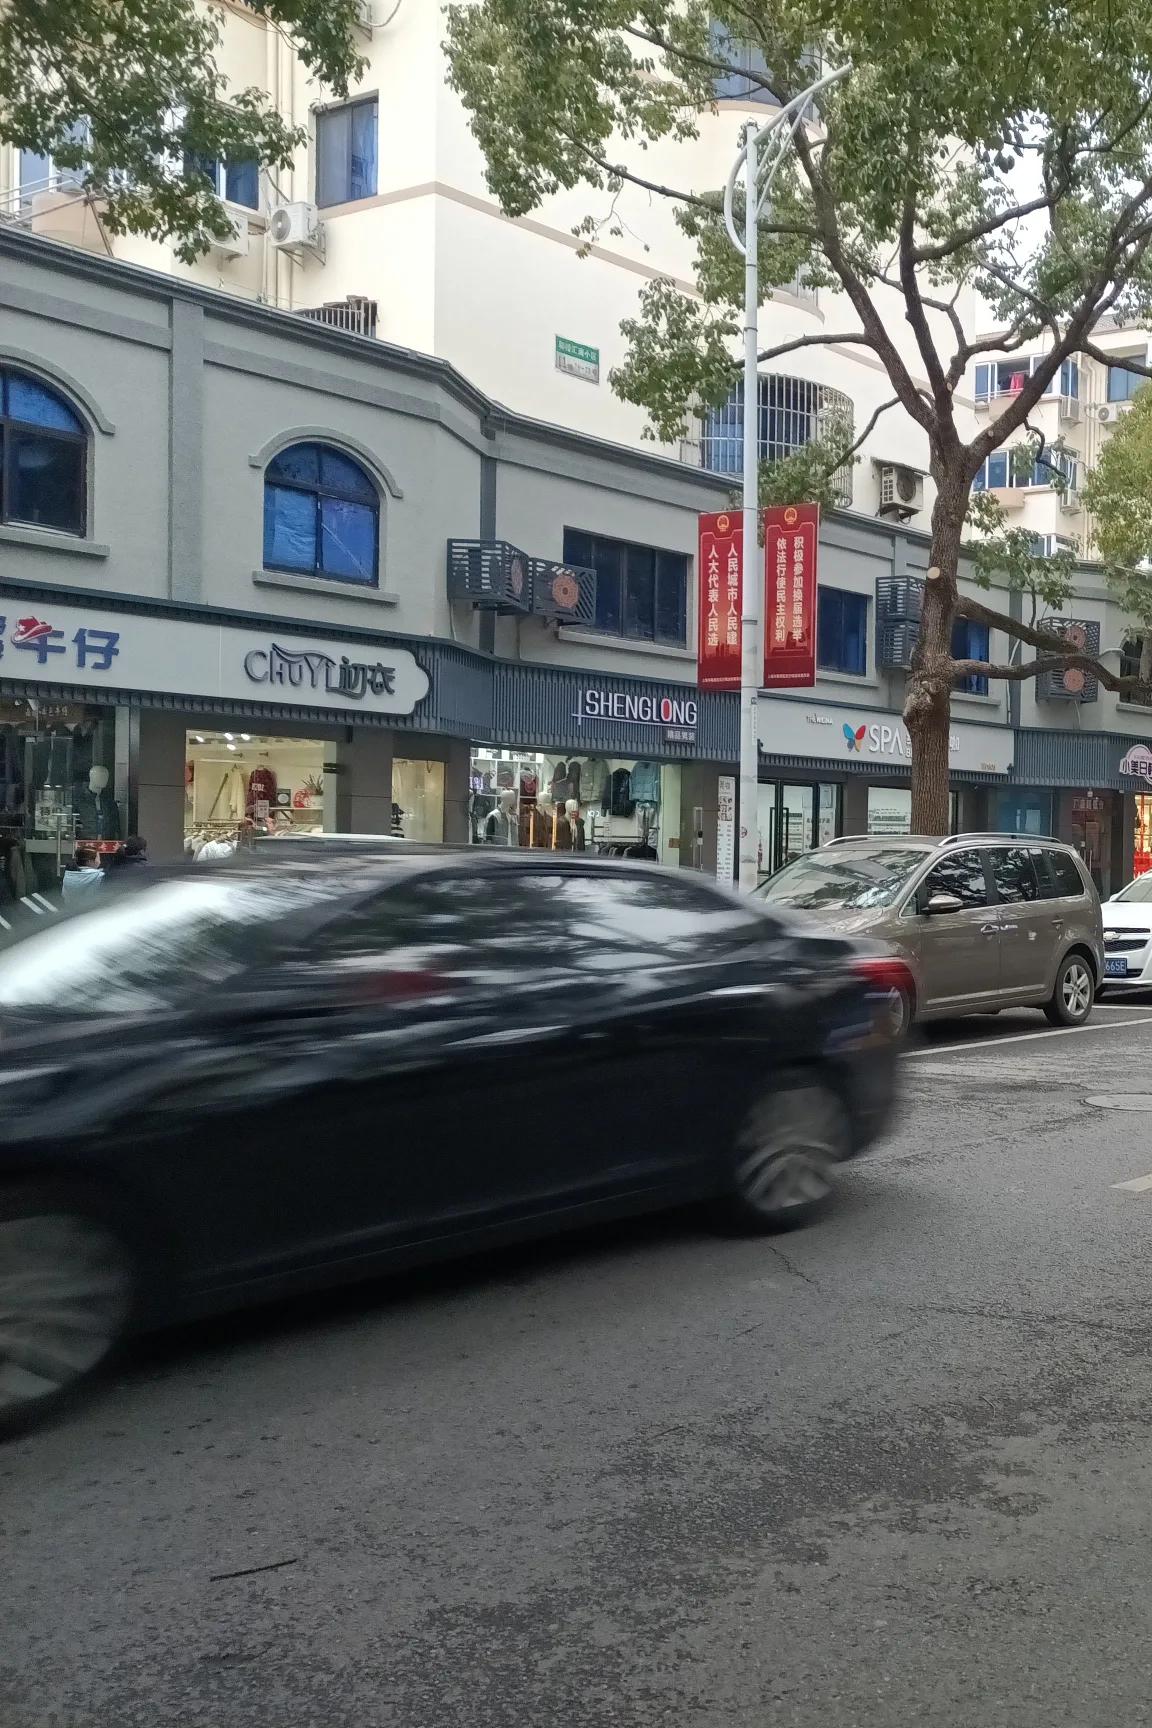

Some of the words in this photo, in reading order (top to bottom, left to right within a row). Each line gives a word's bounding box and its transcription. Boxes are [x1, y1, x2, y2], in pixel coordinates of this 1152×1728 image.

[708, 544, 719, 646] 人大代表人民选
[727, 543, 738, 645] 人民城市人民建
[775, 537, 787, 642] 依法行使民主权利
[793, 536, 805, 641] 积极参加换届选举
[586, 690, 697, 724] SHENGLONG
[869, 725, 904, 755] SPA
[1105, 961, 1125, 971] 665E
